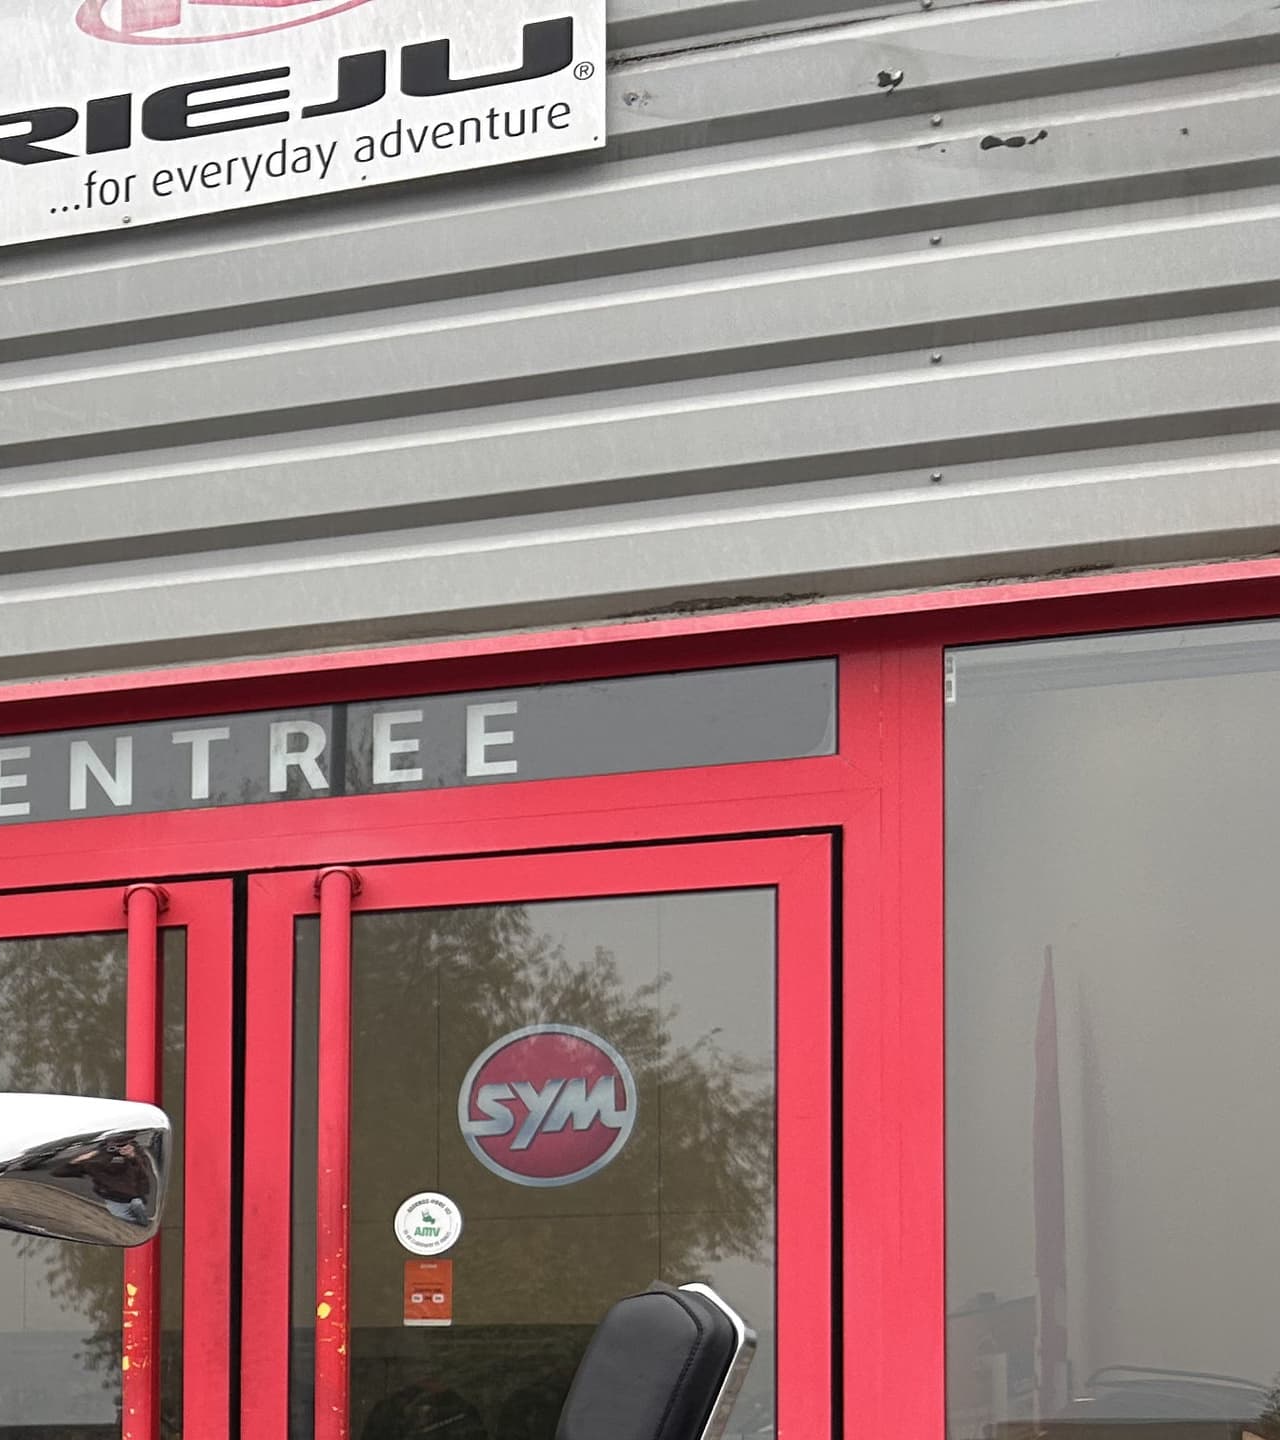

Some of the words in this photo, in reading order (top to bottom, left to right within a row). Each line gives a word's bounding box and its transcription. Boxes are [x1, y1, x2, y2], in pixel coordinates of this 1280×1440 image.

[50, 171, 136, 214] ...for
[151, 136, 337, 195] everyday
[354, 103, 571, 164] adventure
[466, 1076, 627, 1150] SYM
